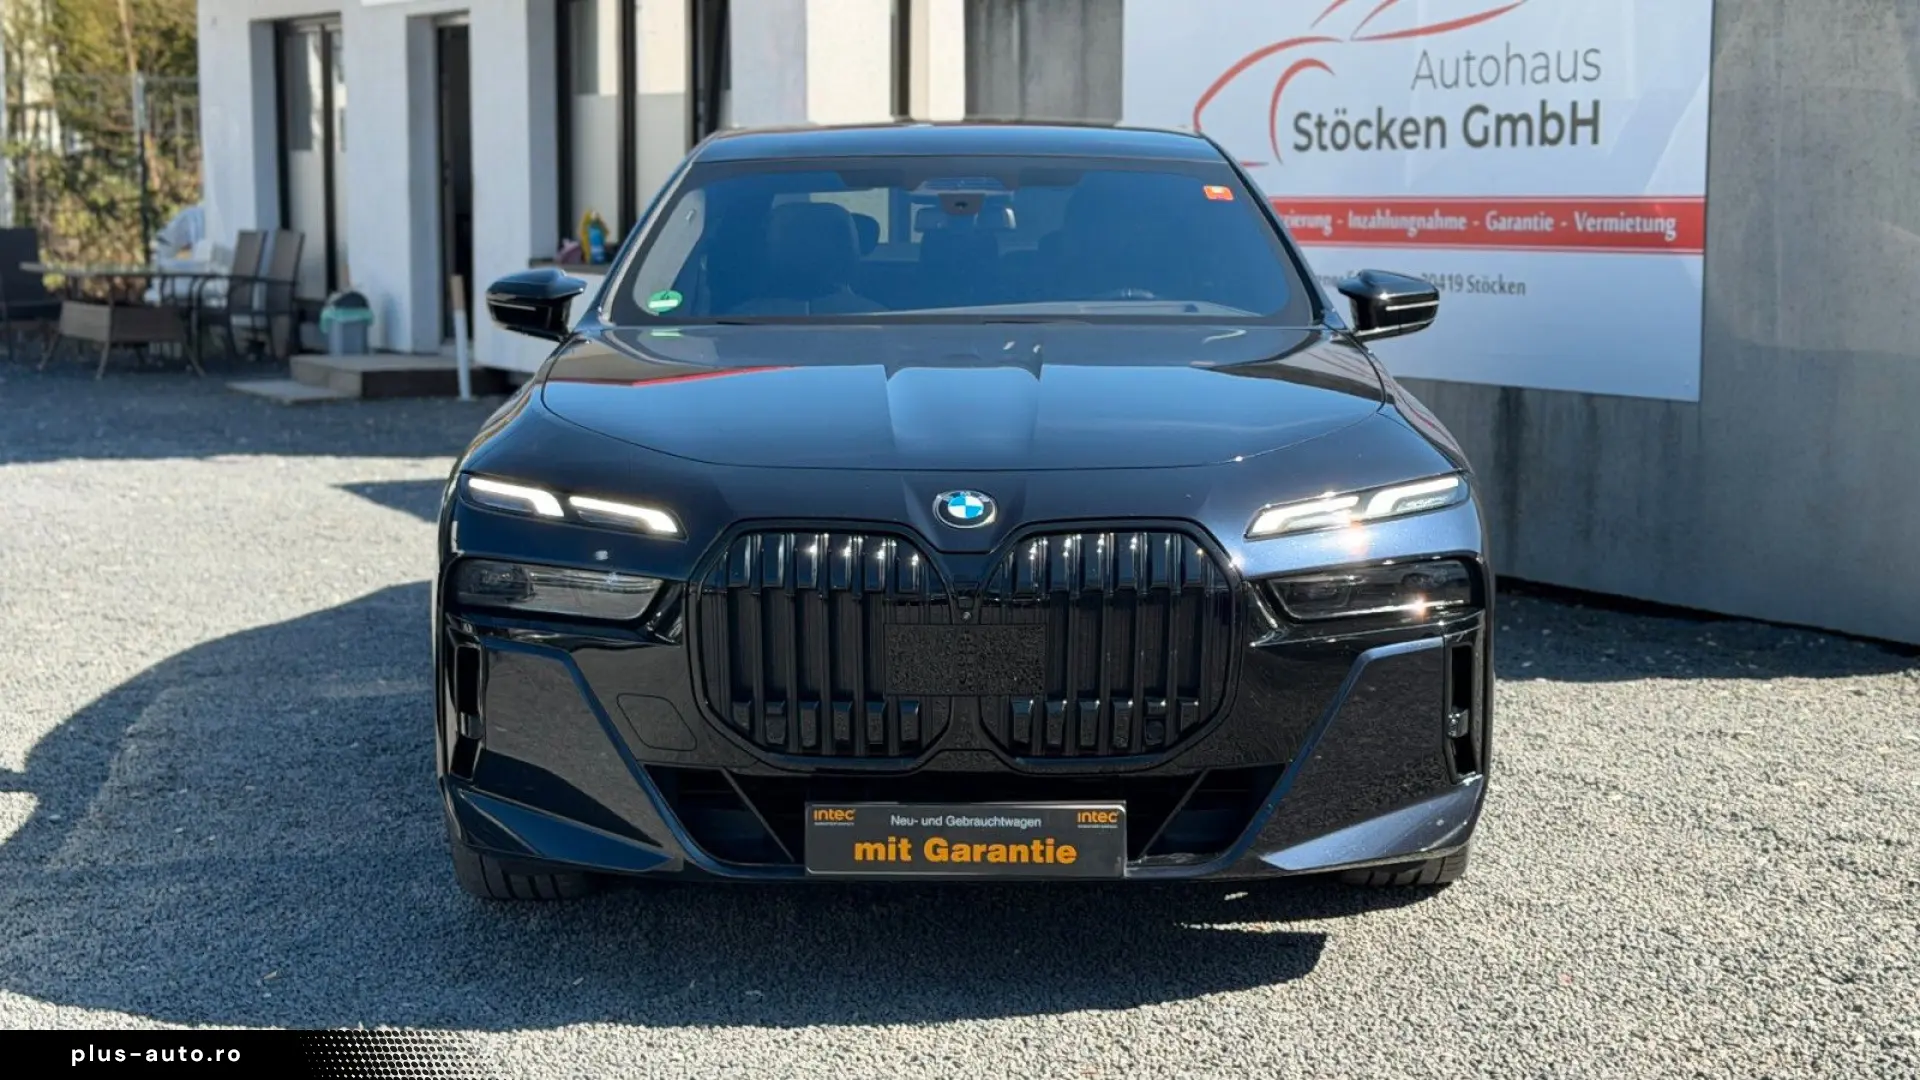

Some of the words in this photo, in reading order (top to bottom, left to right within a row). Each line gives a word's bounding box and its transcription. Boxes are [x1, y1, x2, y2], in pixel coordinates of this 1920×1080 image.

[1411, 42, 1602, 91] Autohaus
[1293, 106, 1447, 152] Stöcken
[1462, 99, 1601, 149] GmbH
[1281, 208, 1333, 237] zierung
[1348, 207, 1468, 238] Inzahlungnahme
[1485, 210, 1555, 232] Garantie
[1573, 210, 1677, 242] Vermietung
[1466, 273, 1526, 296] Stöcken
[890, 814, 919, 827] Neu-
[922, 814, 943, 827] und
[945, 815, 1042, 830] Gebrauchtwagen
[853, 835, 913, 863] mit
[923, 836, 1078, 865] Garantie
